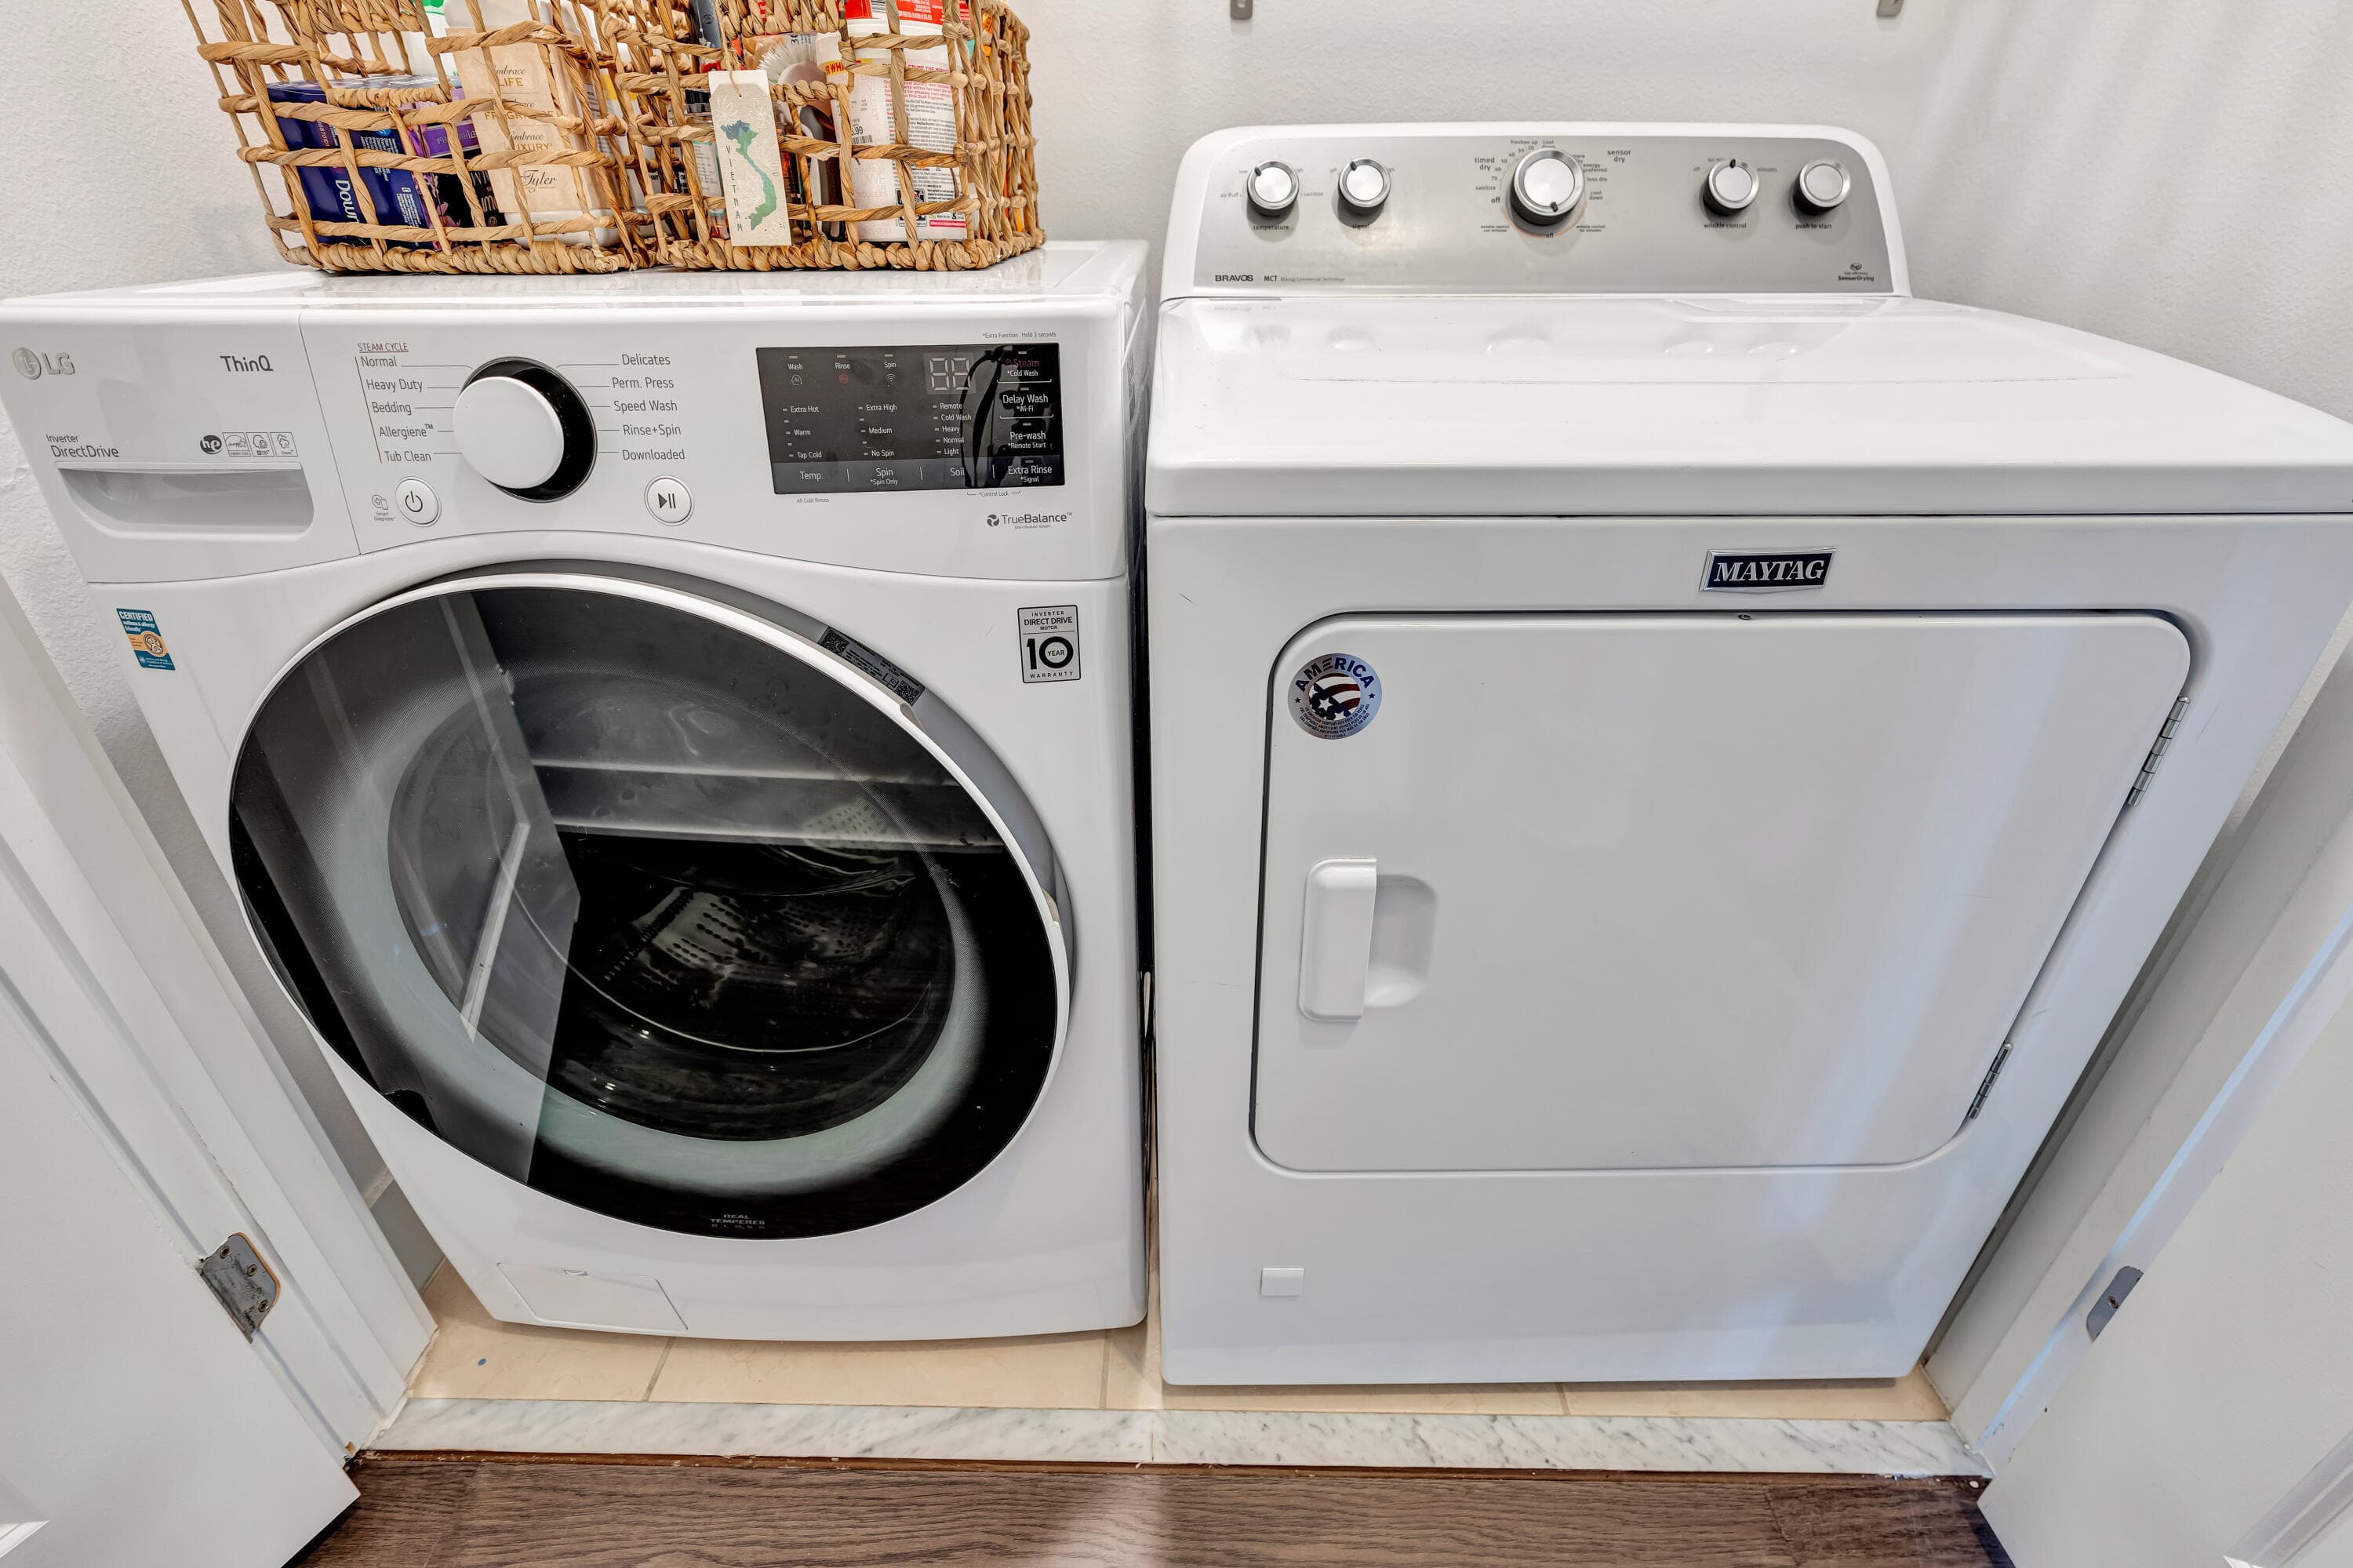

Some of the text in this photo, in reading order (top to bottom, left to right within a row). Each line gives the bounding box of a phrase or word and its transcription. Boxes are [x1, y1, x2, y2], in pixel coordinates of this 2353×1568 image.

[494, 65, 526, 75] mbrace
[521, 169, 558, 193] Tyler
[726, 144, 743, 231] VIETNAM
[335, 179, 359, 223] Down
[358, 342, 409, 352] STEAM CYCLE
[42, 352, 75, 375] LG
[220, 355, 274, 373] ThinQ
[361, 356, 397, 367] Normal
[622, 354, 671, 366] Delicates
[1013, 359, 1039, 368] Steam
[366, 378, 423, 393] Heavy Duty
[612, 377, 675, 389] Perm. Press
[1002, 394, 1049, 406] Delay Wash
[372, 402, 412, 416] Bedding
[614, 400, 678, 414] Speed Wash
[623, 424, 682, 438] Rinse+Spin
[1009, 431, 1046, 441] Pre-wash
[45, 434, 78, 444] Inverter
[50, 446, 119, 458] DirectDrive
[384, 450, 431, 462] Tub Clean
[622, 449, 685, 461] Downloaded
[799, 471, 824, 481] Temp.
[876, 467, 893, 477] Spin
[950, 467, 966, 477] Soil
[1008, 465, 1053, 475] Extra Rinse
[1713, 560, 1825, 582] MAYTAG
[118, 611, 154, 621] CERTIFIED
[1026, 636, 1074, 670] 10
[1295, 657, 1374, 693] AMERICA
